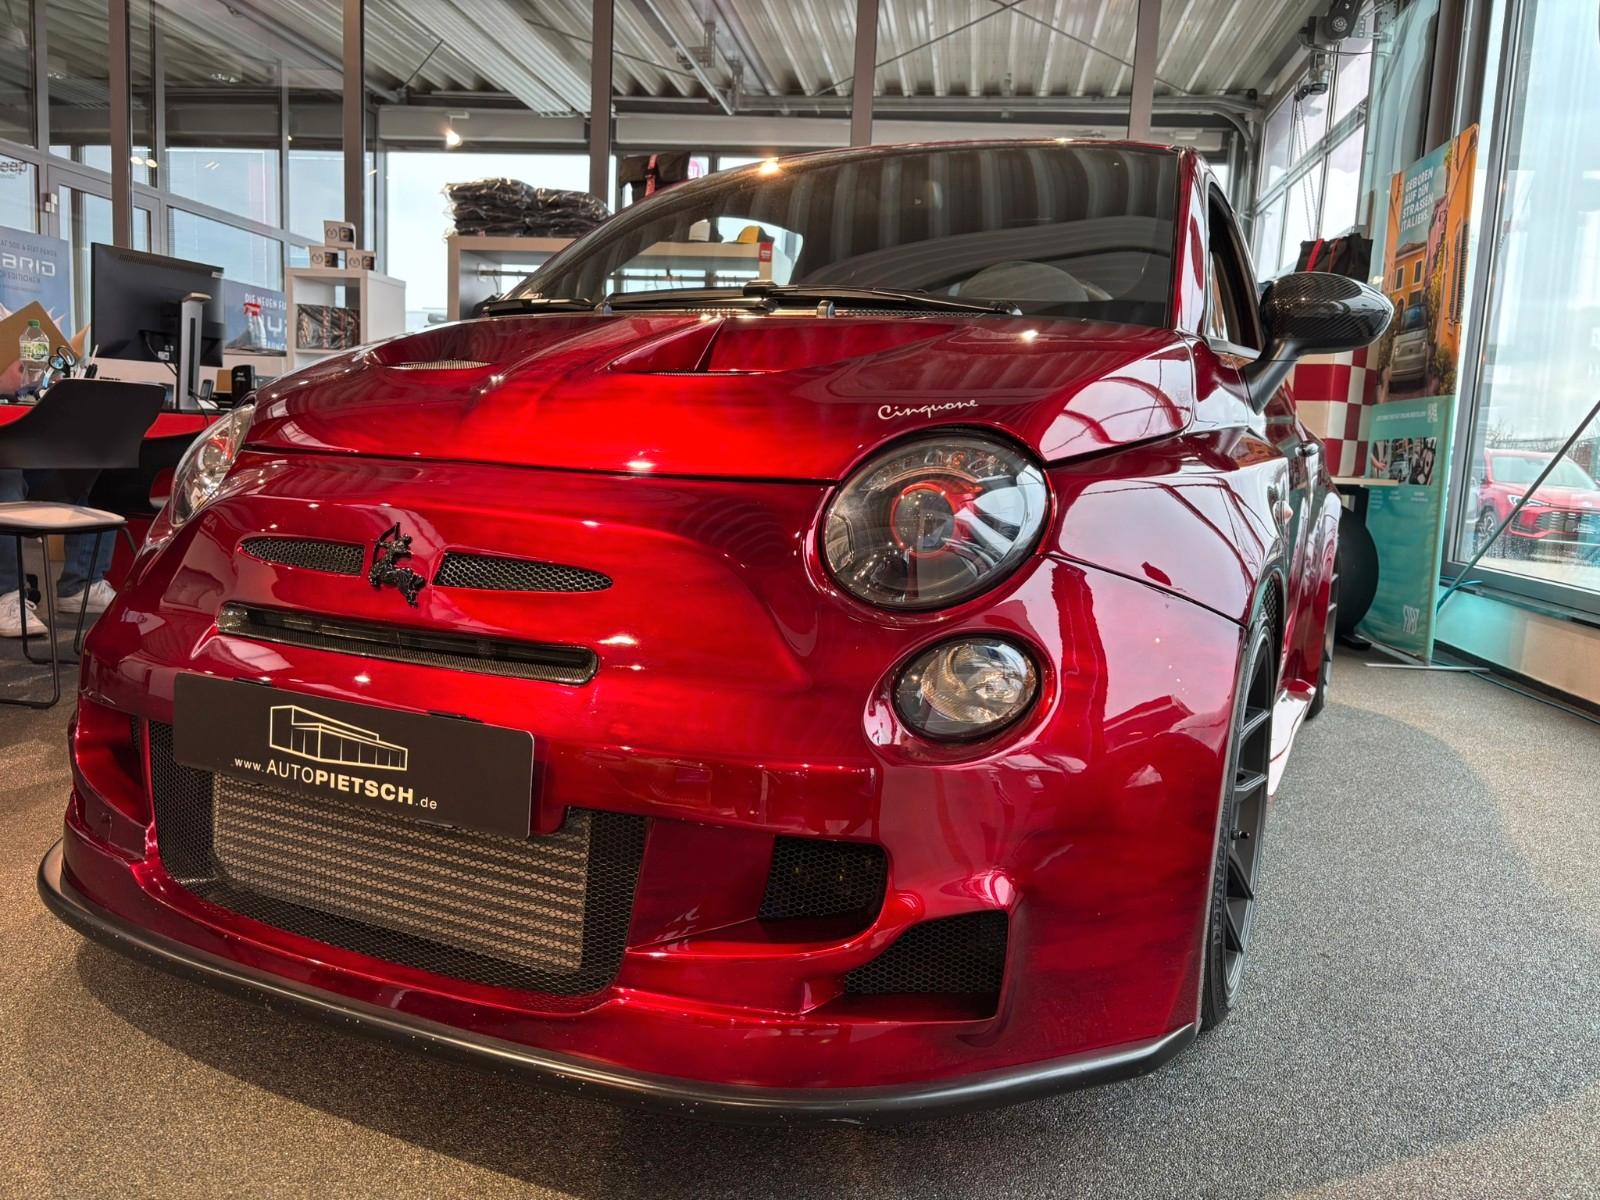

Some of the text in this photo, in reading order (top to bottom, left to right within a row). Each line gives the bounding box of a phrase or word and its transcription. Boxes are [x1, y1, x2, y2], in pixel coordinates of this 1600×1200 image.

[0, 161, 27, 175] eep
[1405, 166, 1434, 192] GEBOREN
[1402, 192, 1434, 219] STRASSEN
[1404, 182, 1429, 206] AUF DEN
[2, 252, 56, 277] BRID
[244, 293, 256, 304] DIE
[877, 399, 979, 420] Cinquone
[1213, 828, 1227, 929] DUNLOP
